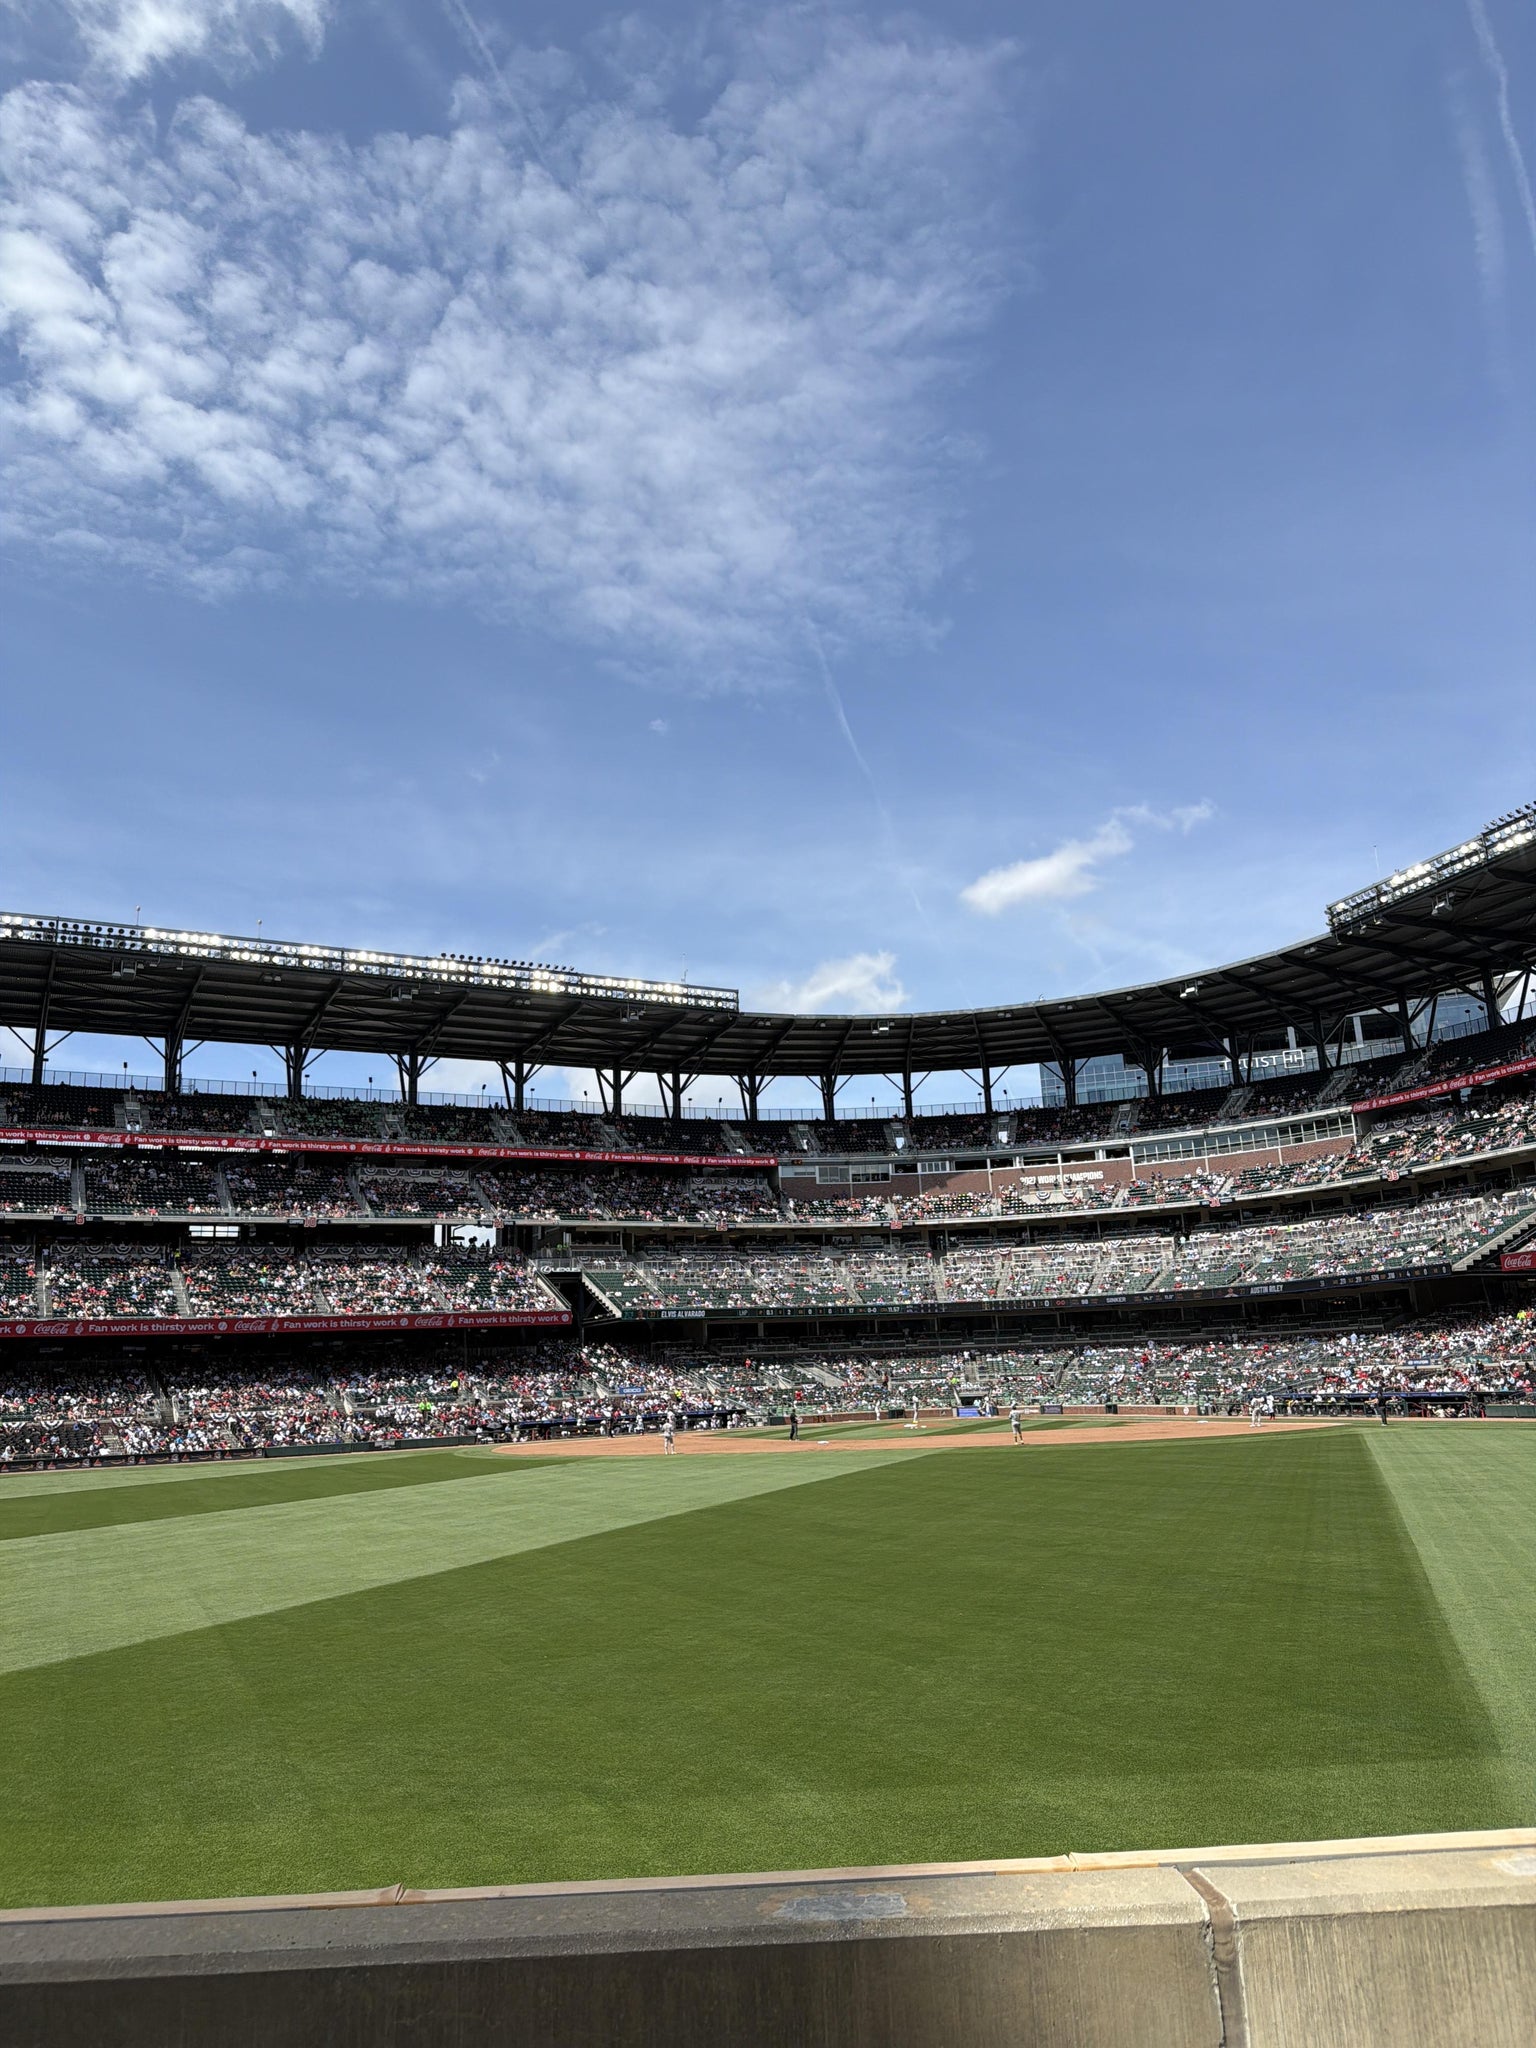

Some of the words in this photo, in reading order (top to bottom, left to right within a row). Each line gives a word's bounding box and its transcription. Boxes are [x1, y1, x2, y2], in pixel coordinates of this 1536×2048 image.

[1224, 1055, 1277, 1071] TUIST
[1507, 1064, 1525, 1072] thirsty
[35, 1133, 60, 1141] thirsty
[176, 1138, 200, 1146] thirsty
[76, 1213, 84, 1225] 6
[304, 1217, 317, 1228] 10
[1250, 1286, 1268, 1294] AUSTIN
[1269, 1284, 1283, 1293] RILEY
[661, 1310, 677, 1318] ELVIS
[678, 1310, 705, 1318] ALVARADO
[151, 1323, 186, 1332] thirsty
[340, 1320, 371, 1328] thirsty
